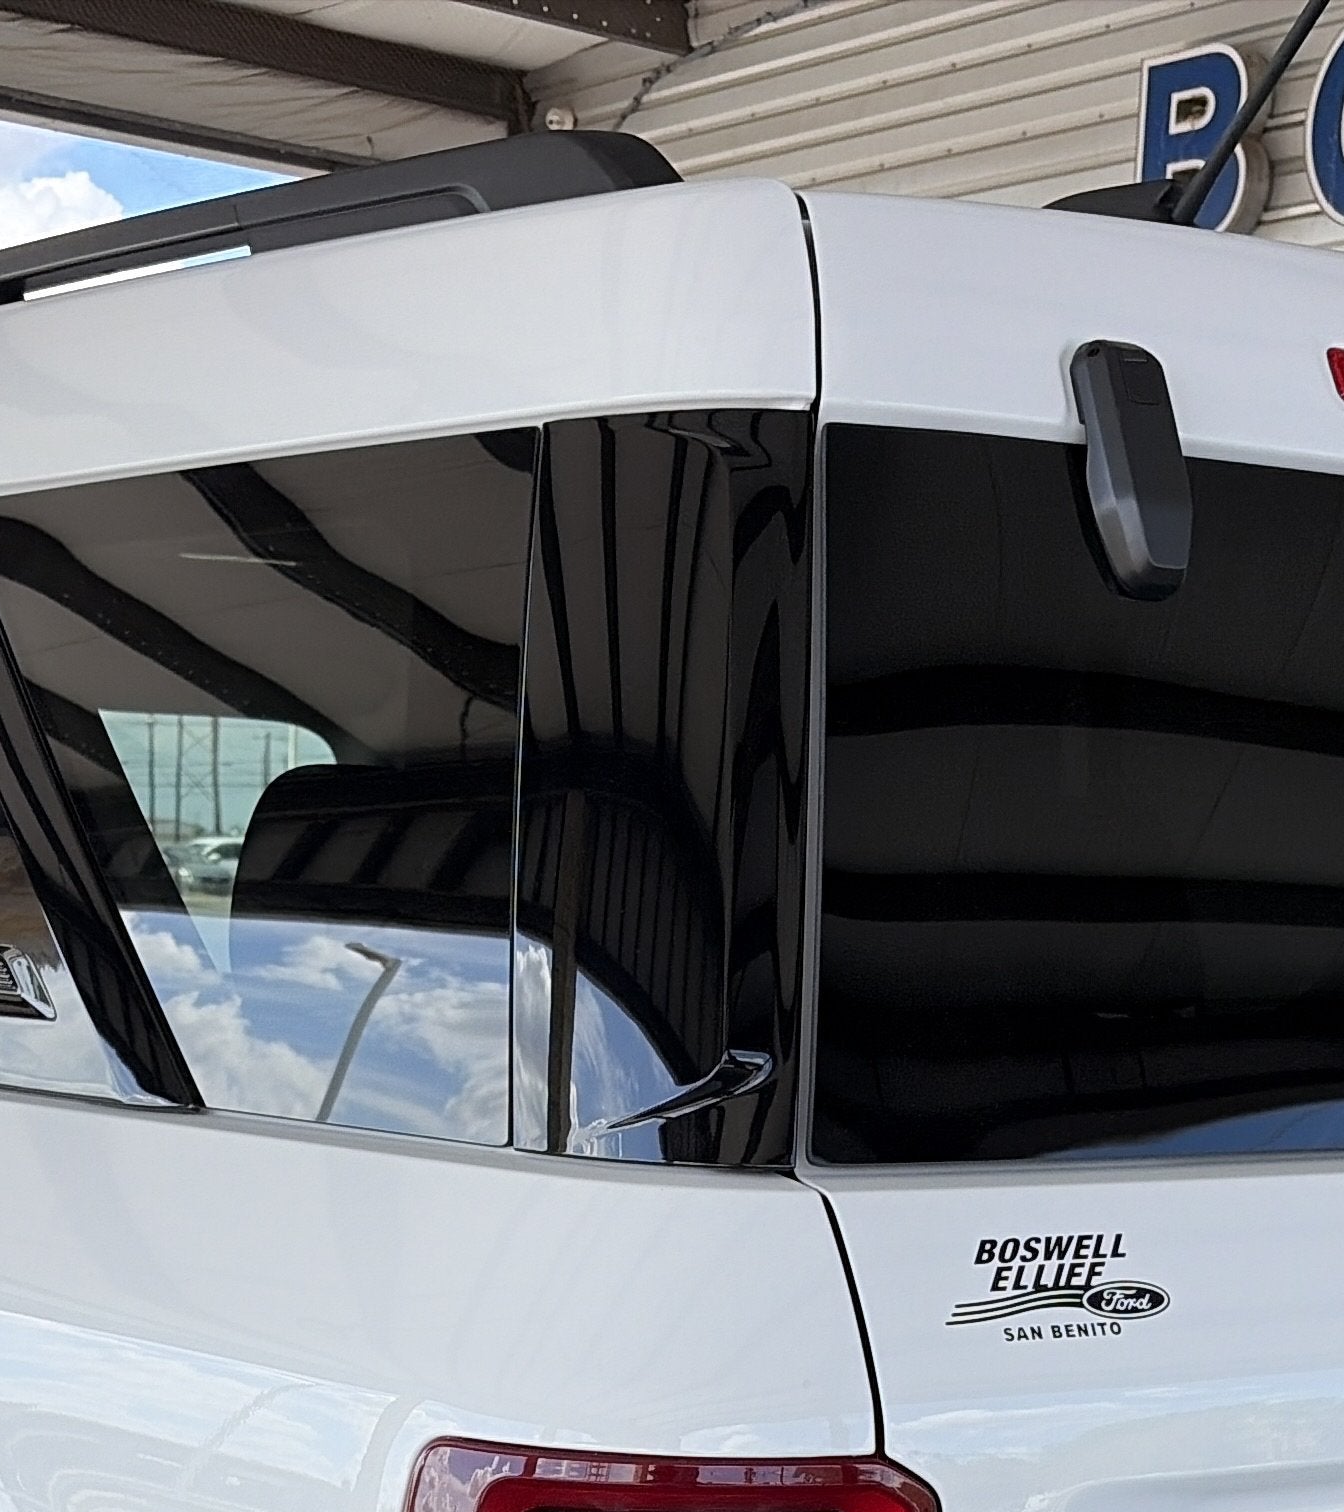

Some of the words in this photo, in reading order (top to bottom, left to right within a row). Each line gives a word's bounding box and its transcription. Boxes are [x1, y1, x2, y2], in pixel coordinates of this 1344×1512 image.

[974, 1233, 1127, 1265] BOSWELL
[990, 1261, 1106, 1292] ELLIFF
[1102, 1288, 1153, 1311] Ford
[1003, 1325, 1043, 1342] SAN
[1052, 1321, 1122, 1339] BENITO
